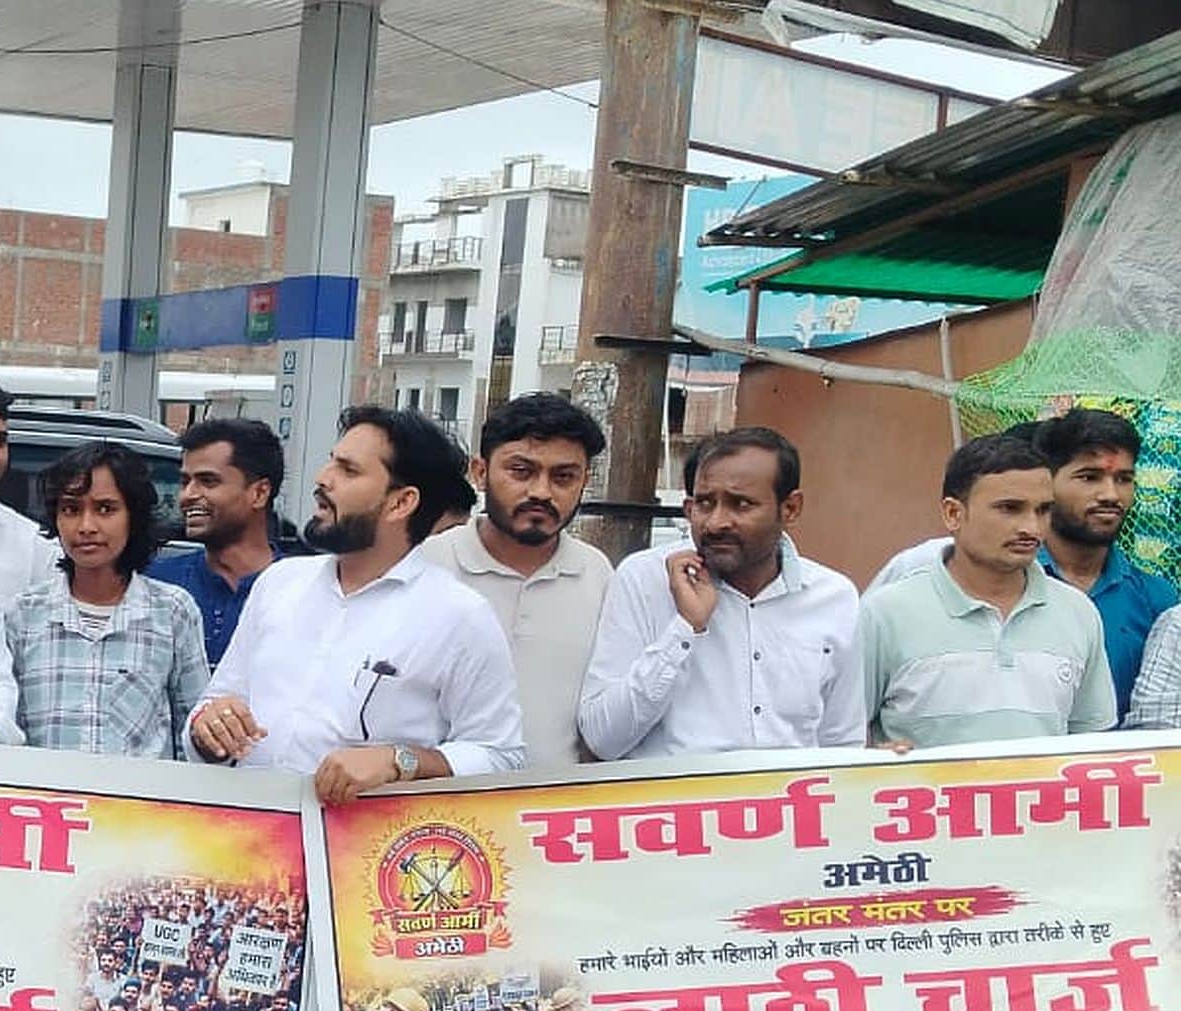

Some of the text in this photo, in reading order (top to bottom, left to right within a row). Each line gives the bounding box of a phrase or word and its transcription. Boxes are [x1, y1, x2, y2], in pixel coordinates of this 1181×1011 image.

[522, 758, 1161, 863] सवर्ण आर्मी
[824, 852, 931, 888] अमेठी
[780, 896, 976, 927] जंतर मंतर पर
[155, 925, 180, 942] UGC
[675, 936, 887, 966] और और पर
